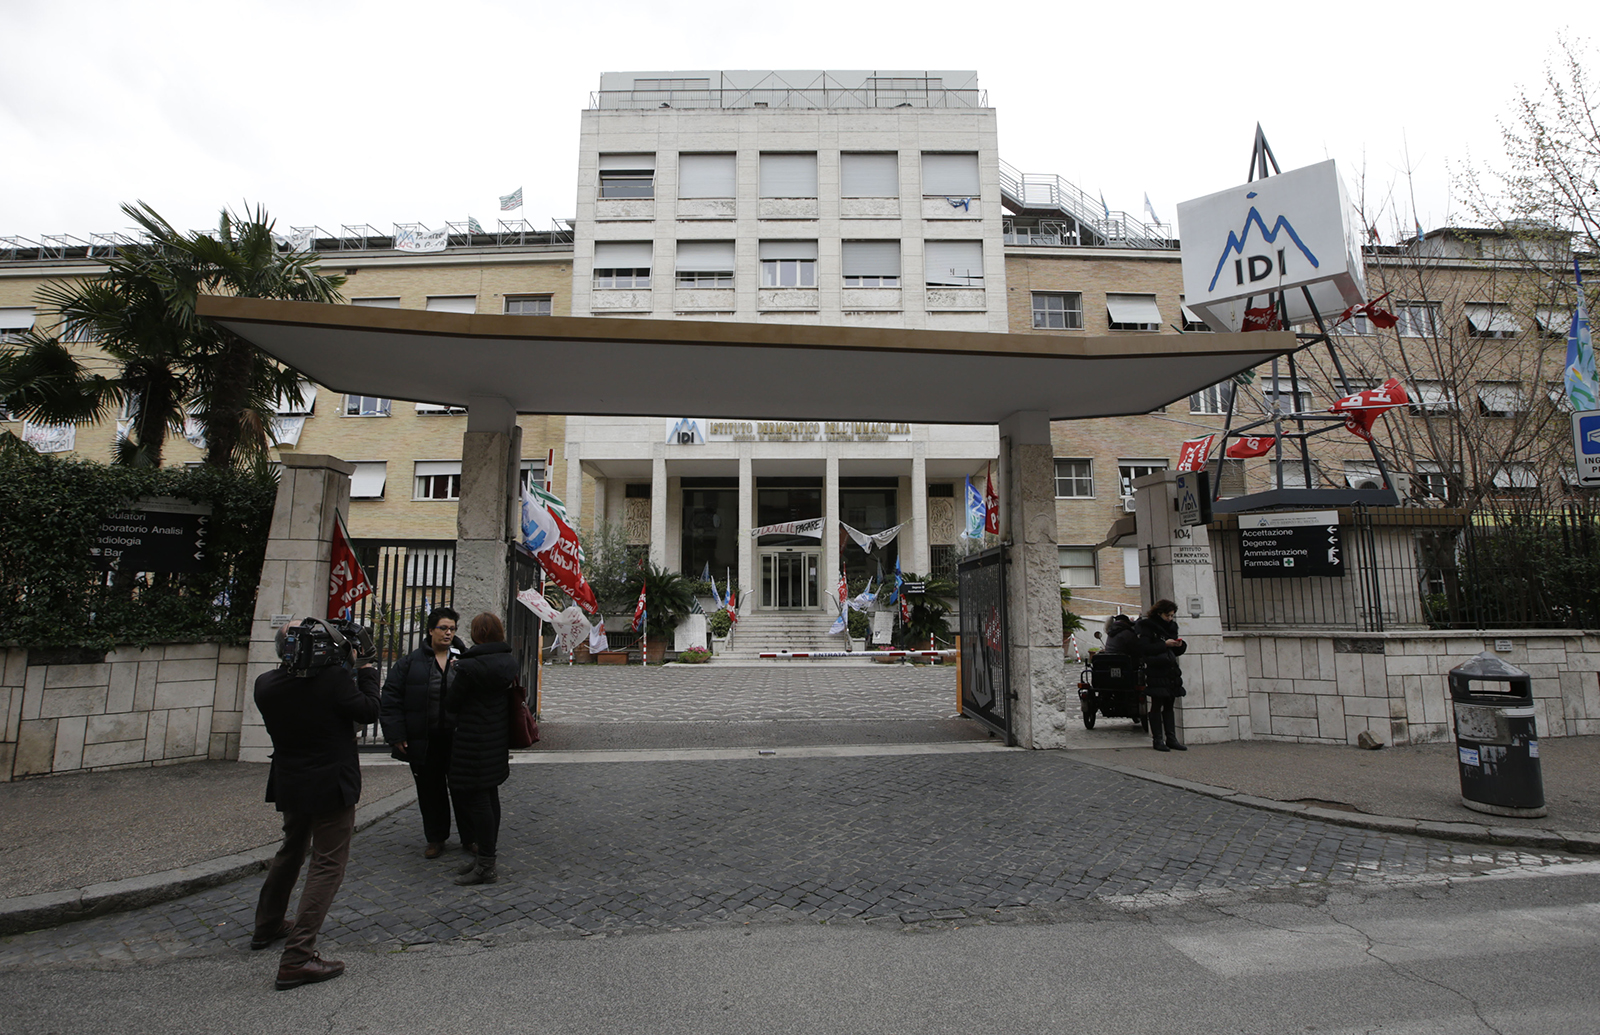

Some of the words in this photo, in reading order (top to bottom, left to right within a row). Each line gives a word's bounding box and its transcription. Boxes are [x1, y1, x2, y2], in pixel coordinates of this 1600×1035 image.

[1235, 248, 1287, 286] IDI
[709, 422, 753, 434] ISTITUTO
[756, 422, 820, 434] DERMOPATICO
[677, 431, 694, 444] IDI
[151, 526, 183, 535] Analisi
[1174, 529, 1191, 540] 104
[1242, 528, 1293, 537] Accettazione
[1242, 539, 1277, 548] Degenze
[104, 548, 123, 557] Bar
[1244, 548, 1308, 557] Amministrazione
[1244, 559, 1280, 567] Farmacia
